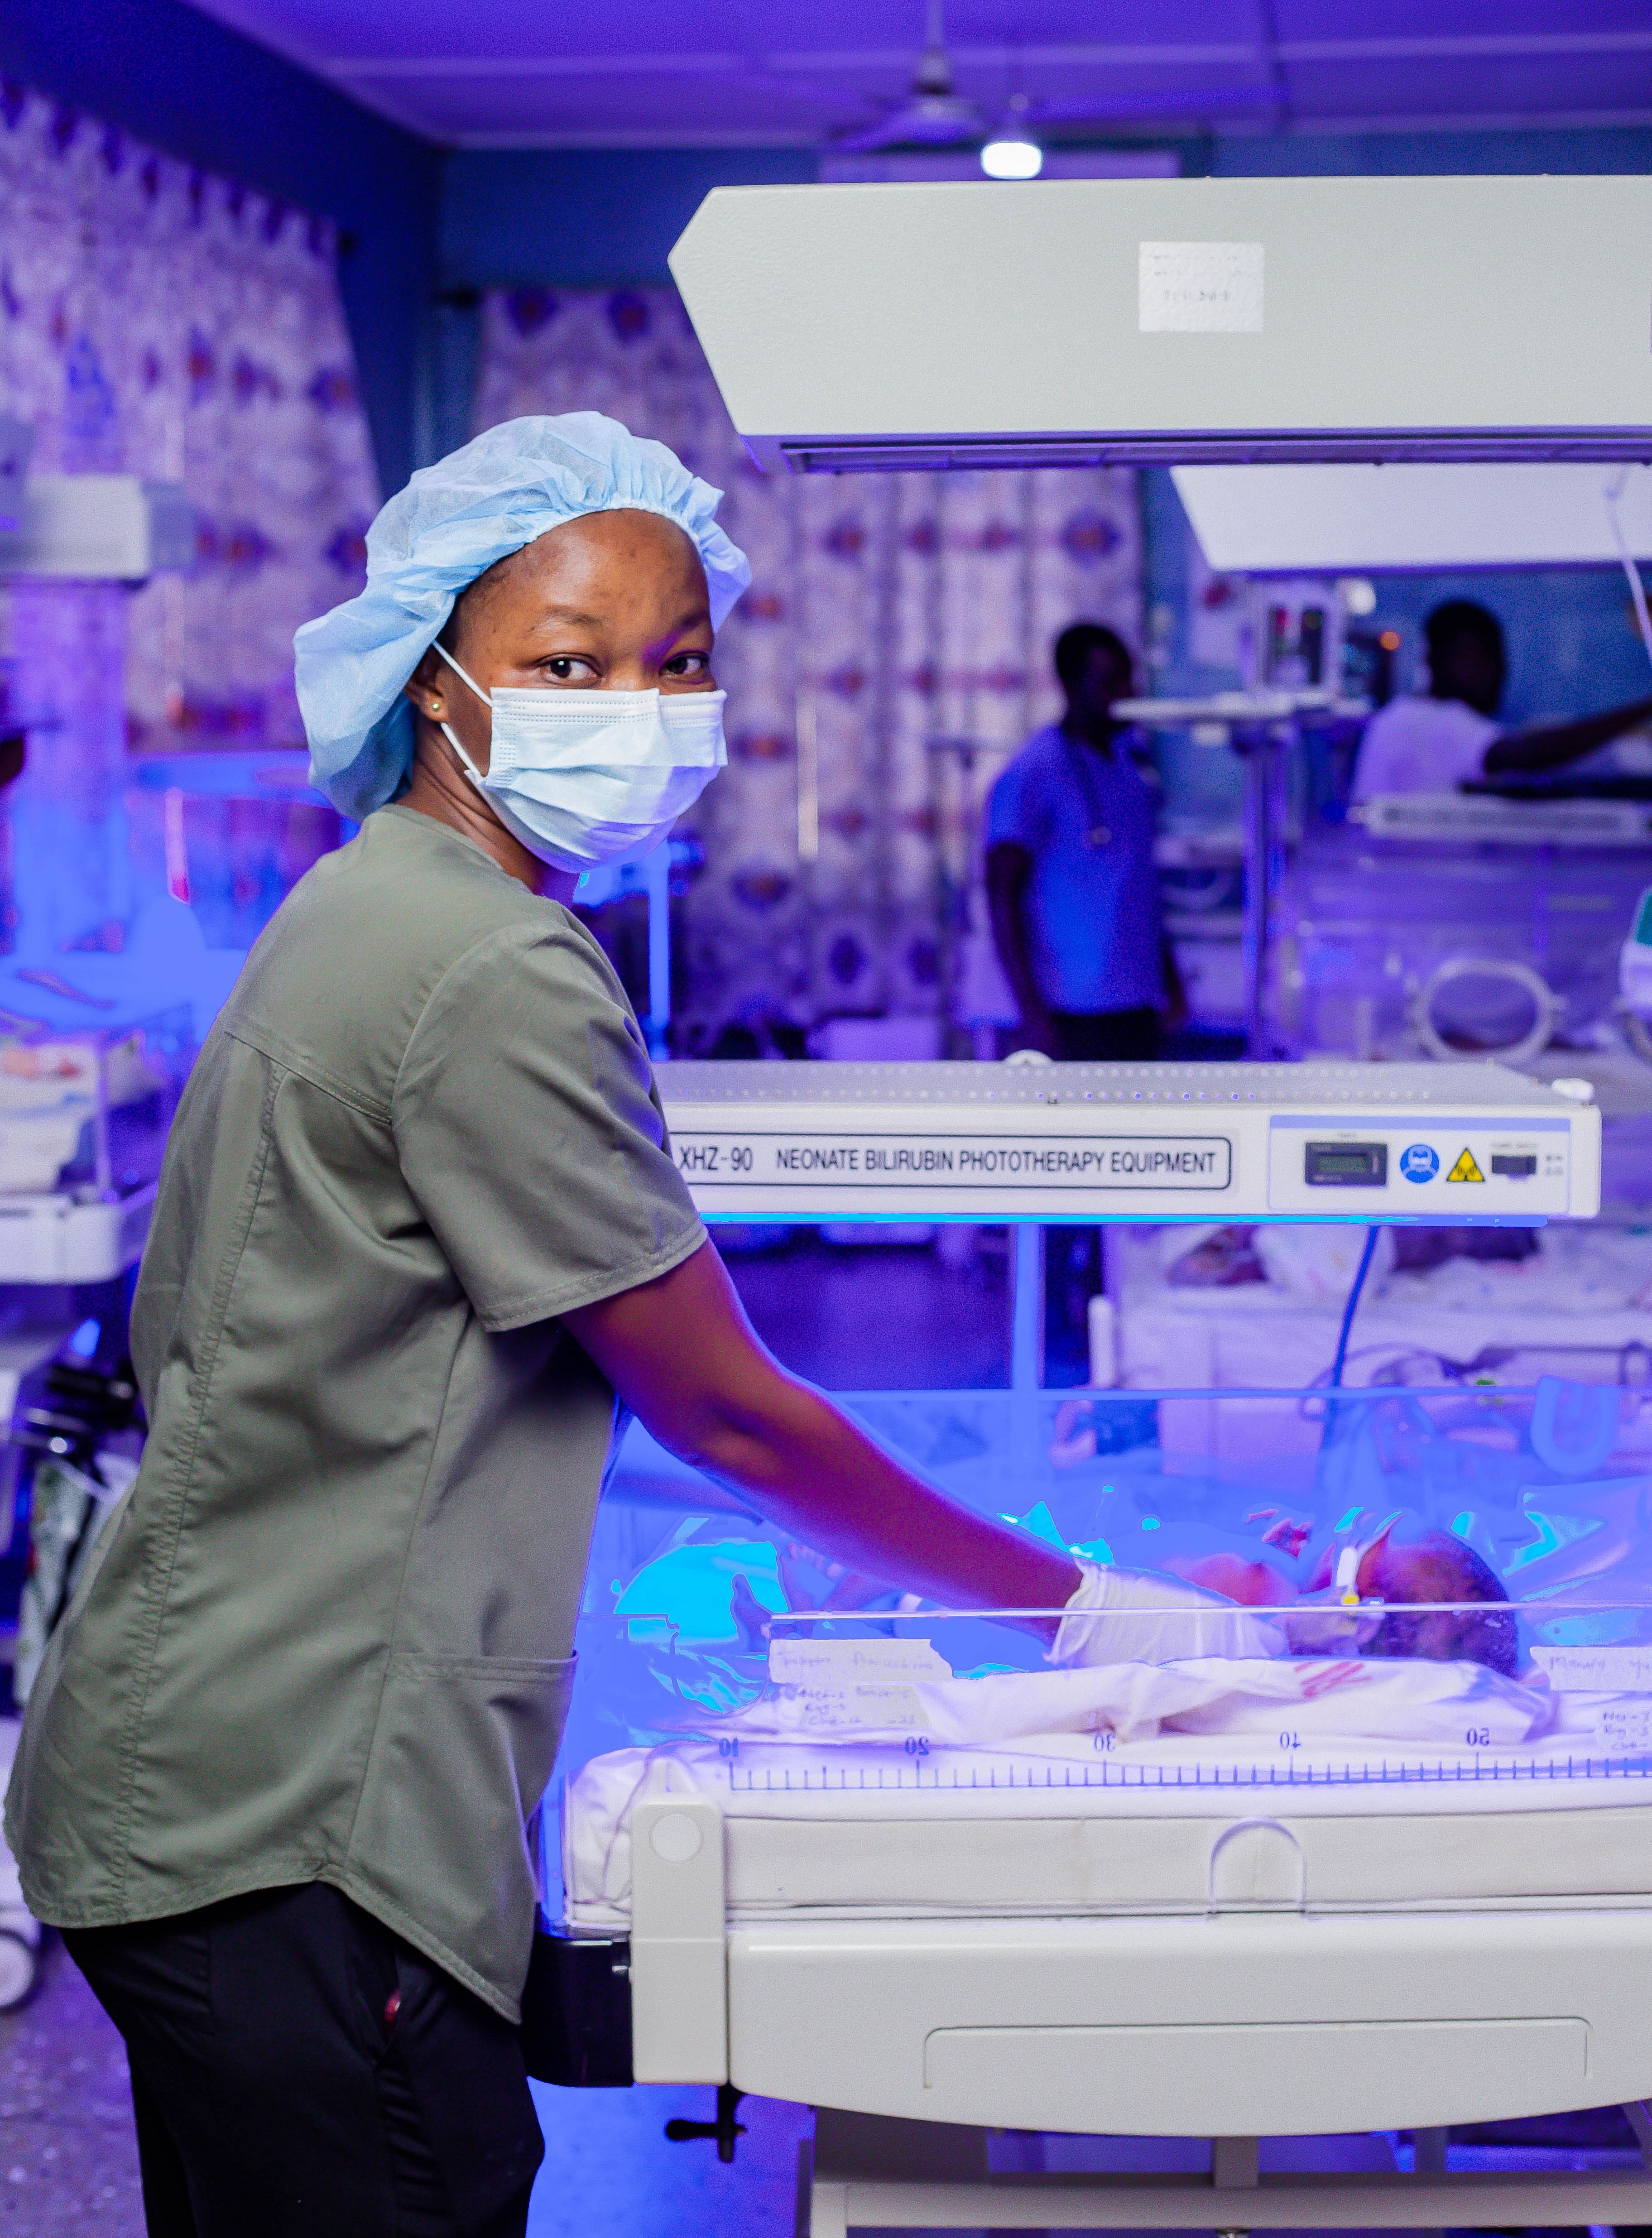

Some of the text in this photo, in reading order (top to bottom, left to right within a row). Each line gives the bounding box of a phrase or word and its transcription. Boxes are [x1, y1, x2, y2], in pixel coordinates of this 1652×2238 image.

[777, 1148, 859, 1171] NEONATE
[865, 1149, 954, 1172] BILIRUBIN
[959, 1150, 1105, 1172] PHOTOTHERAPY
[1111, 1151, 1217, 1173] EQUIPMENT
